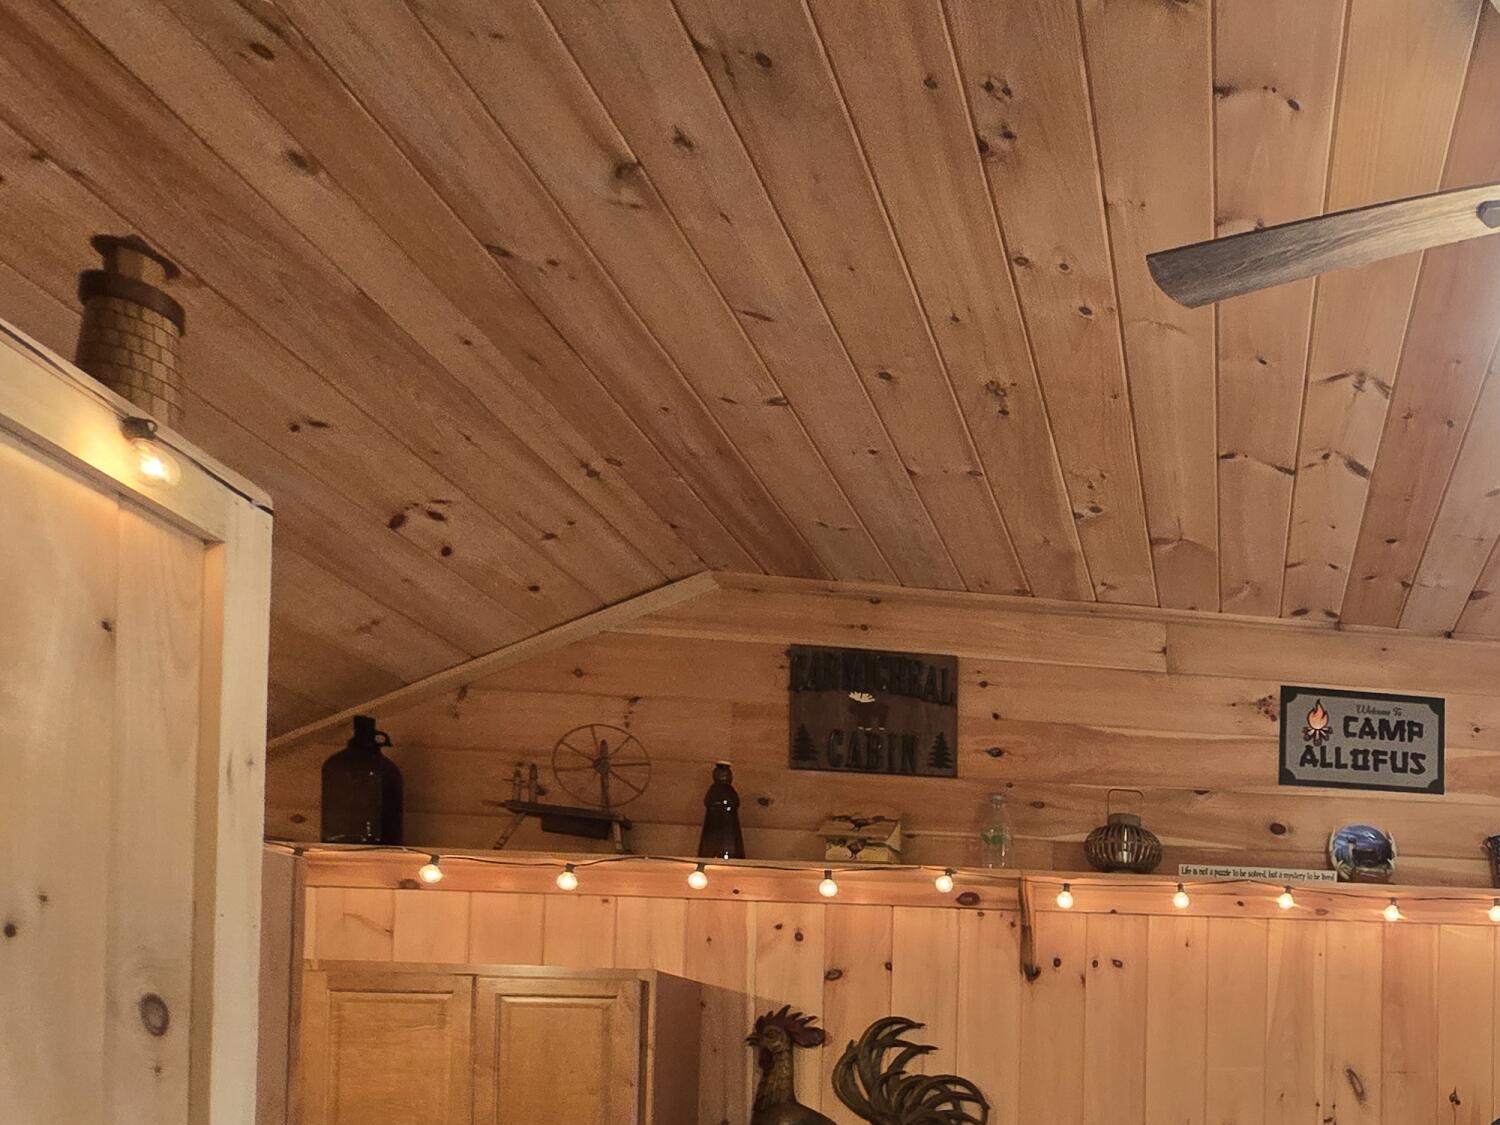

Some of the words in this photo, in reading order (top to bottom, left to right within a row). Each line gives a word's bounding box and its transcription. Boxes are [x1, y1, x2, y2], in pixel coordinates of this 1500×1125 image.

[1354, 704, 1390, 716] Welcome
[1343, 715, 1424, 743] CAMP
[828, 729, 918, 772] CABIN
[1300, 745, 1426, 775] ALLOFUS
[1181, 866, 1192, 875] Life
